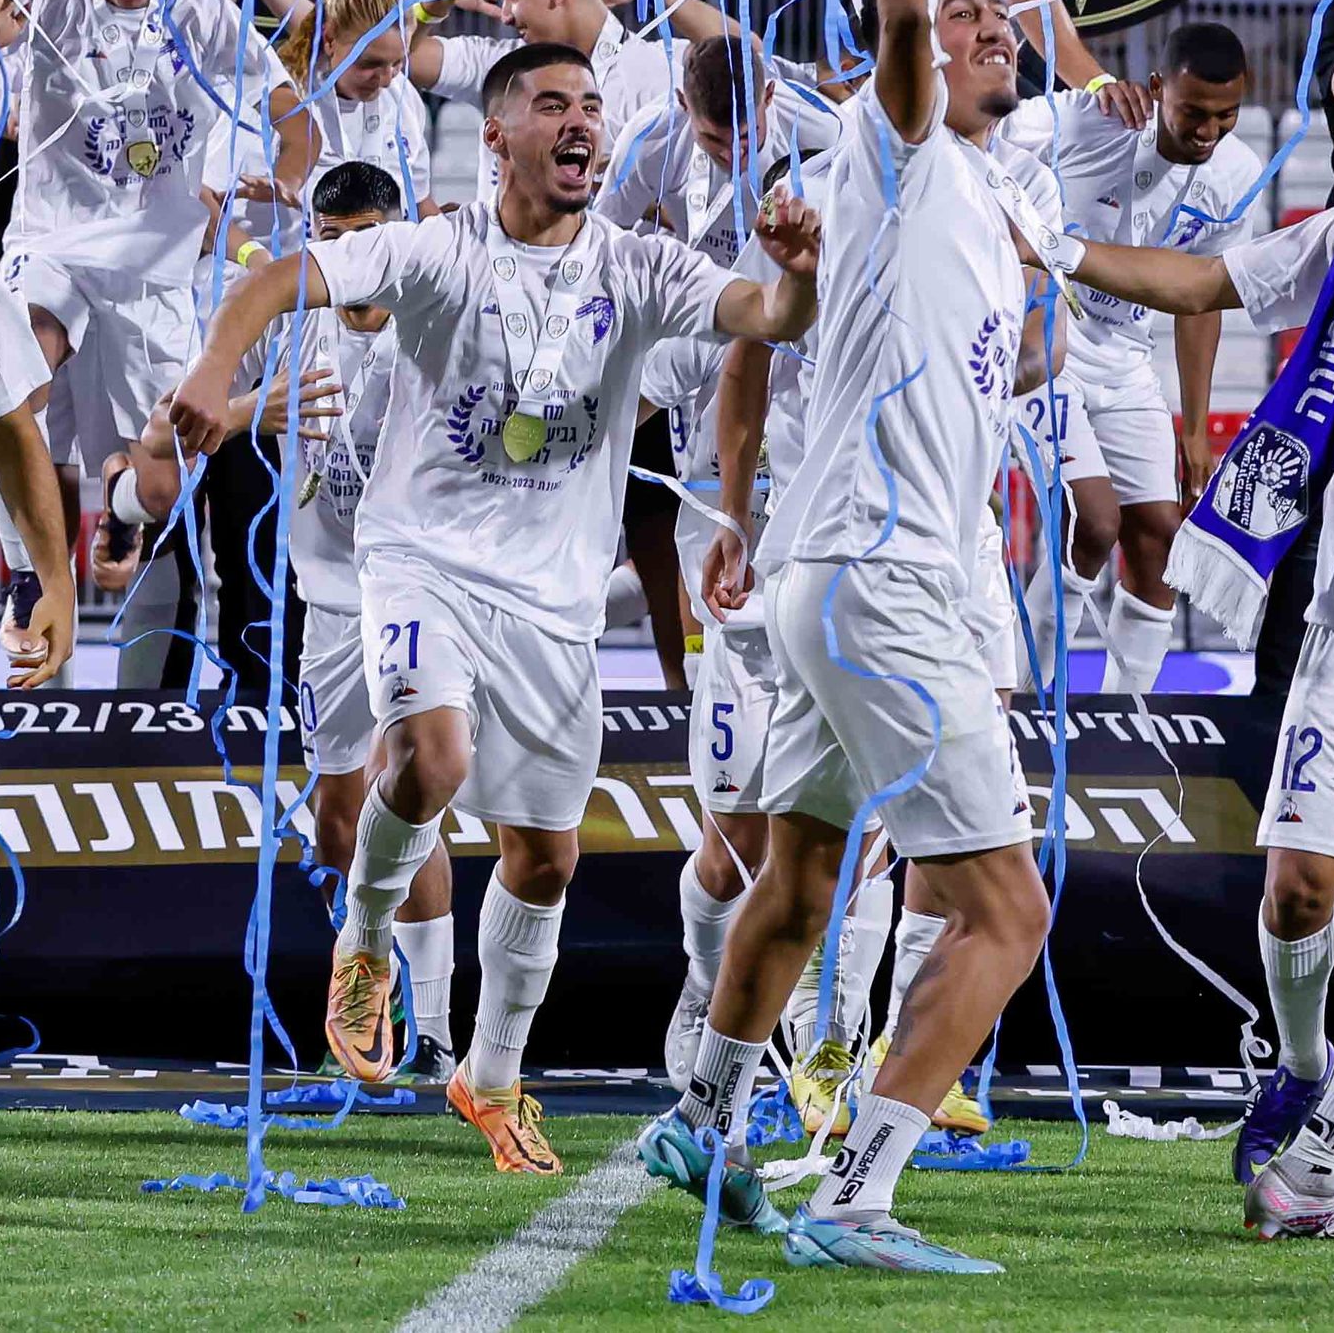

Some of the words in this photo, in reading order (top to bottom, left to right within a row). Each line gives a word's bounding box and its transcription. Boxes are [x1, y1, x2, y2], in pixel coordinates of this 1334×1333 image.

[481, 472, 534, 489] 2022-2023
[379, 620, 420, 678] 21
[711, 701, 735, 762] 5
[1280, 724, 1324, 794] 12
[853, 1122, 895, 1180] TAPEDESIGN
